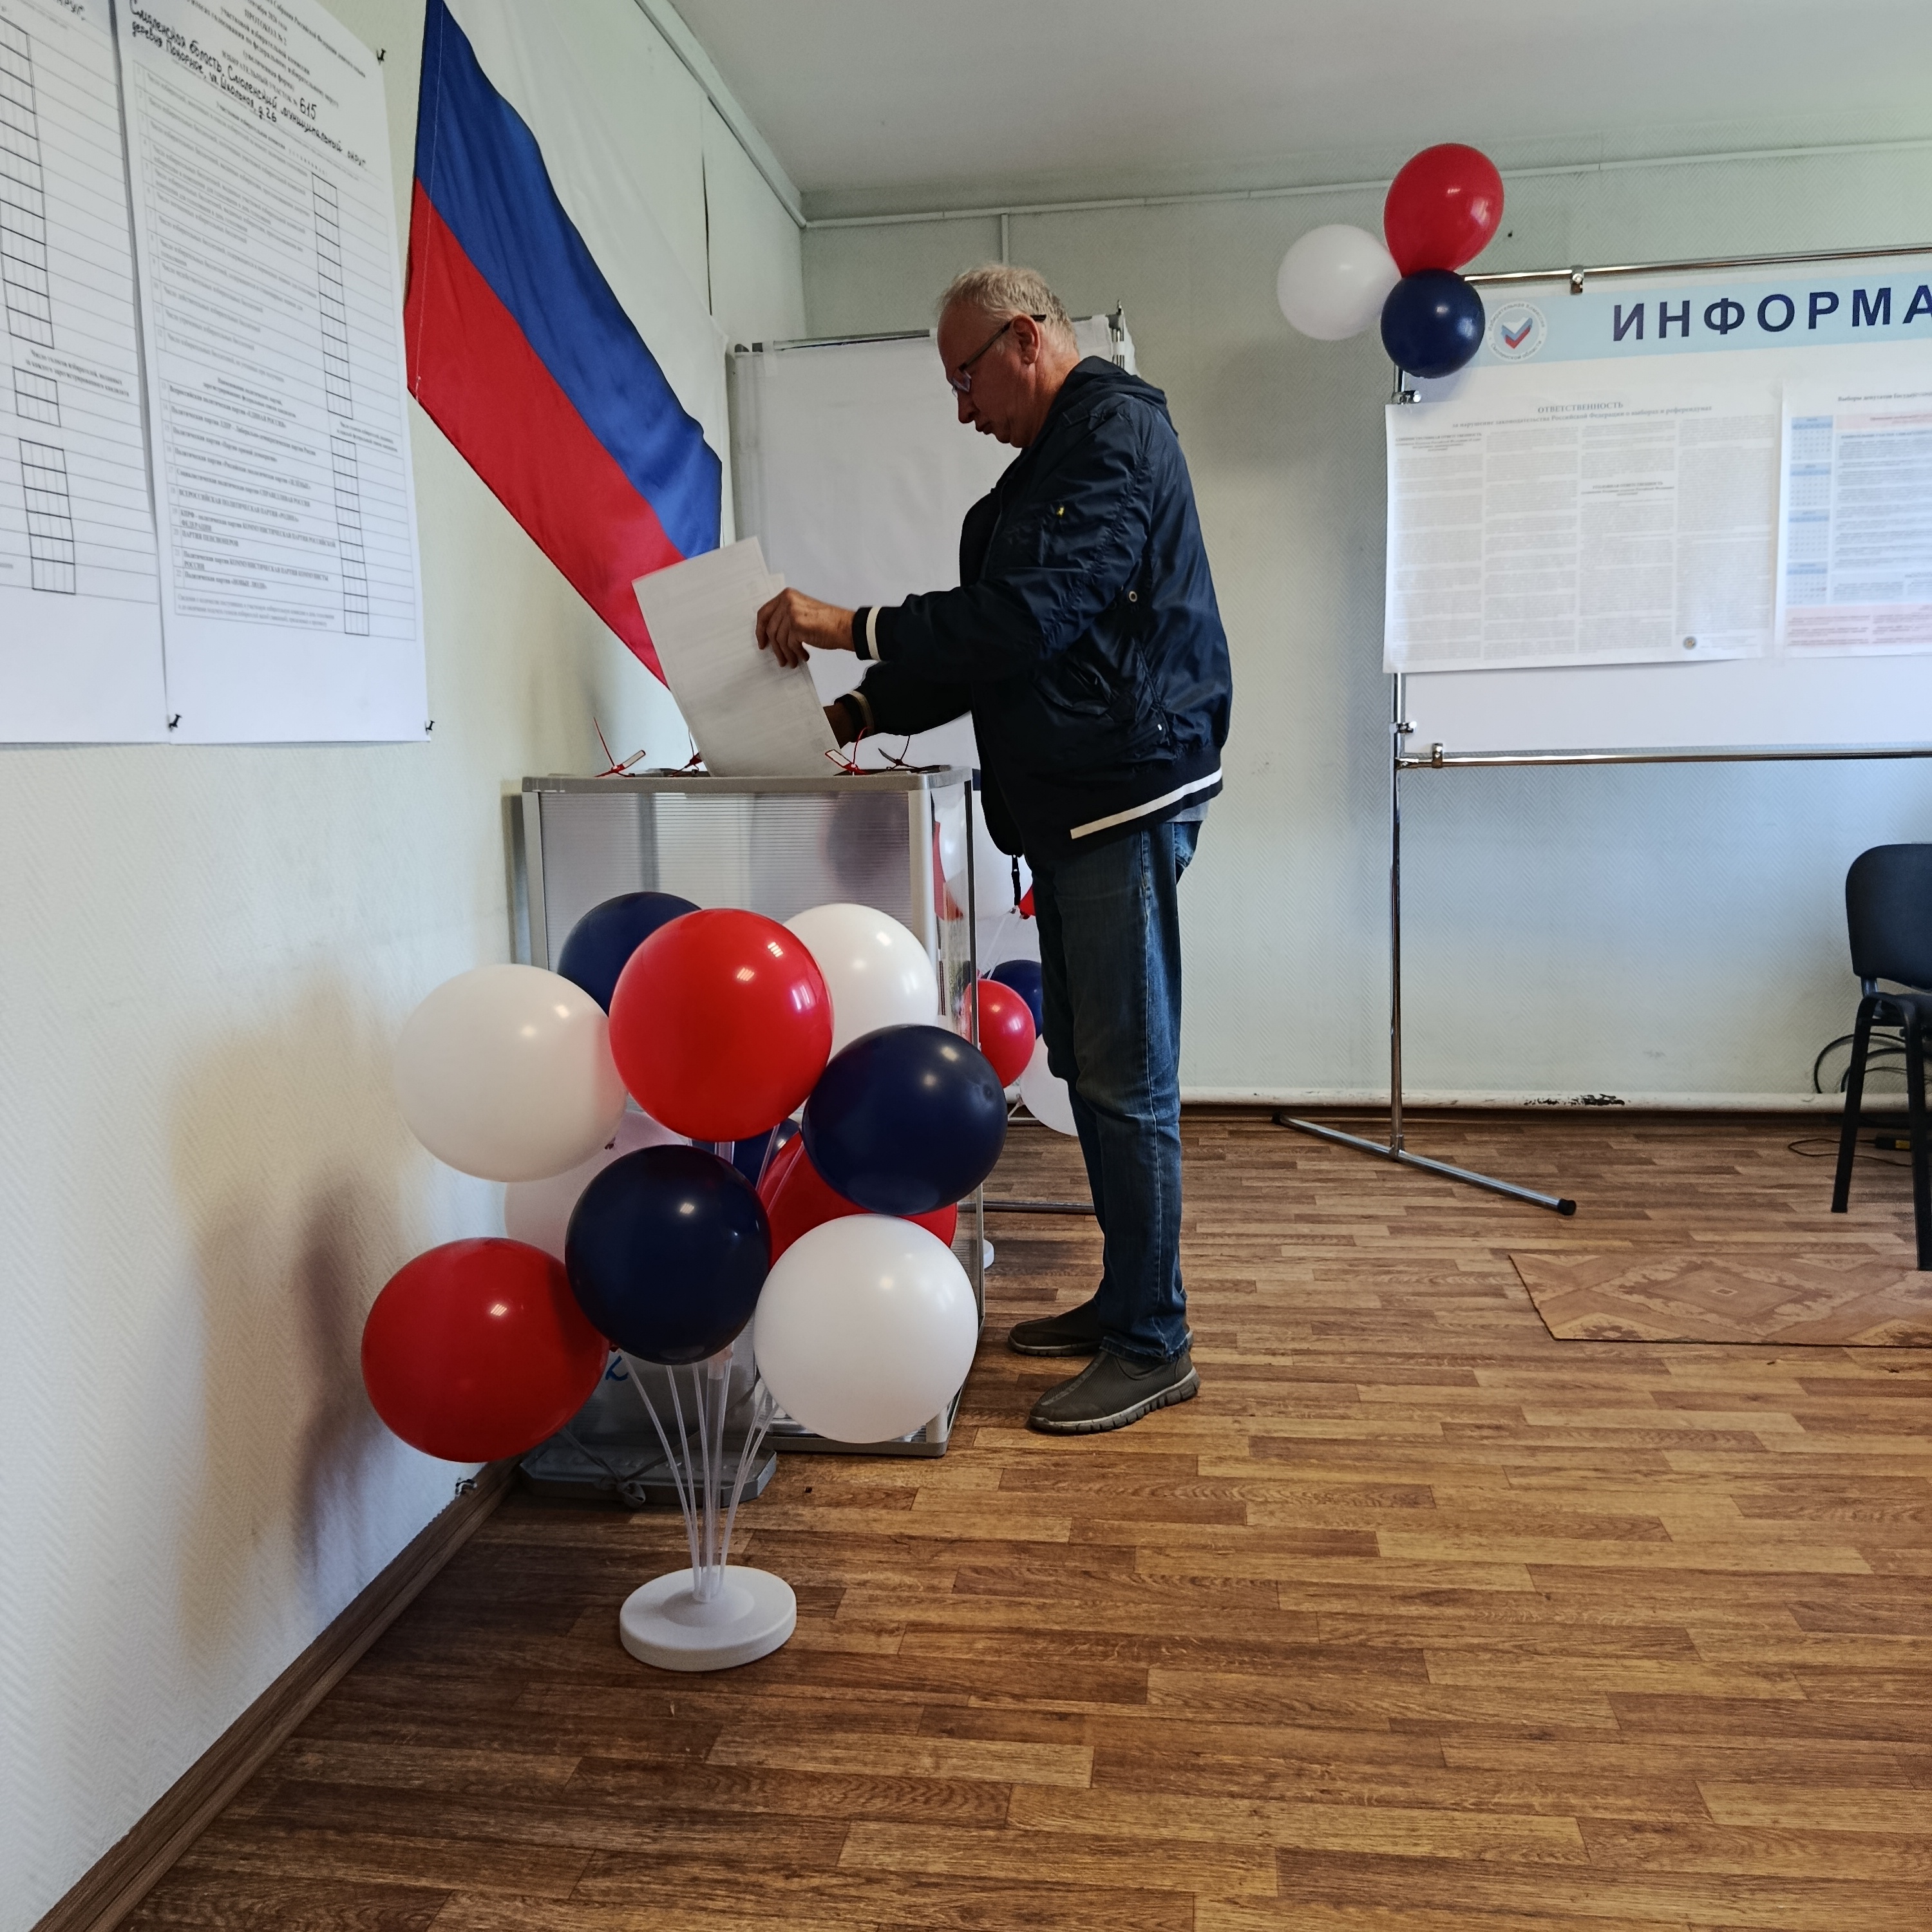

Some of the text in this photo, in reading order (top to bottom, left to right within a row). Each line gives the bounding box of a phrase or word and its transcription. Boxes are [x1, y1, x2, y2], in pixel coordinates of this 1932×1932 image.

[266, 107, 277, 123] 26
[299, 97, 317, 121] 615
[1537, 402, 1624, 413] ОТВЕТСТВЕННОСТЬ
[1551, 413, 1587, 422] Российской
[1589, 410, 1624, 421] Федерации
